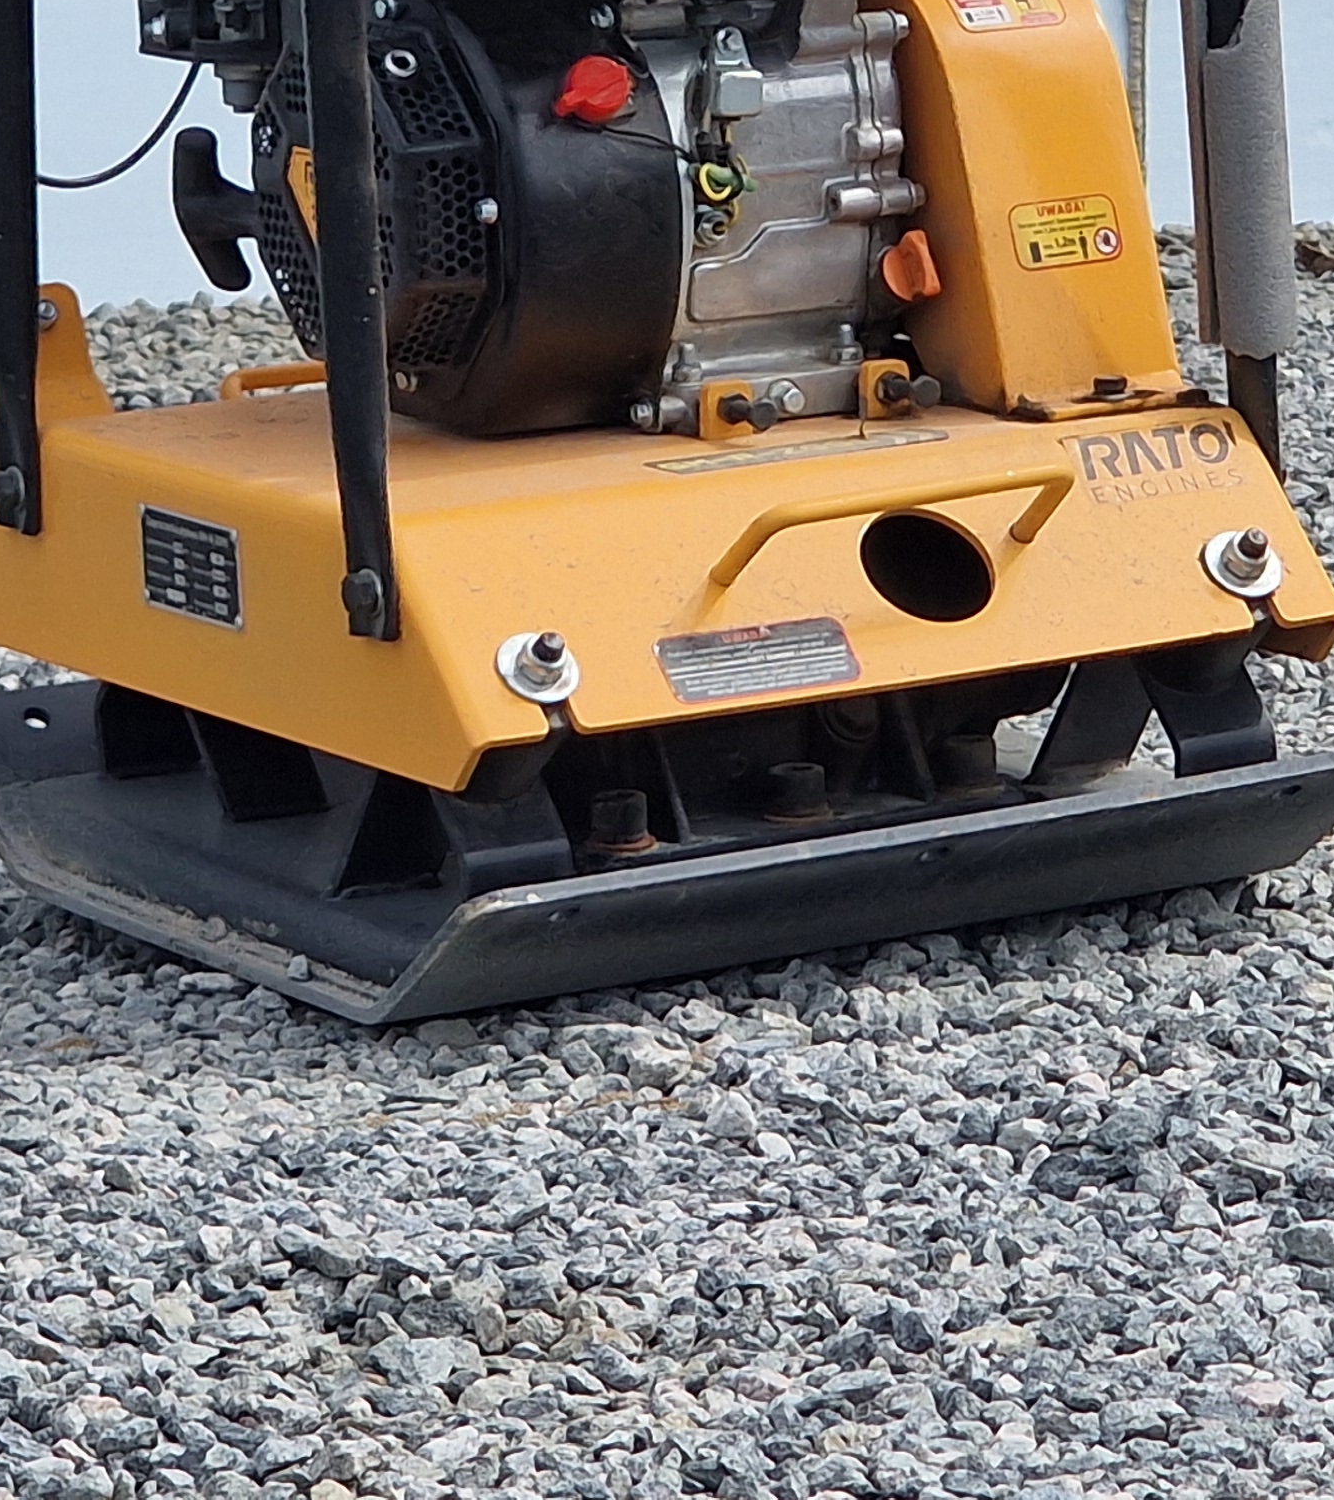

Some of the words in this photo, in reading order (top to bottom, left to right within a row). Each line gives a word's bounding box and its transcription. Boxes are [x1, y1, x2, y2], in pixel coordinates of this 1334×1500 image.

[1036, 200, 1085, 217] UWAGA!
[1078, 423, 1229, 481] RATO
[1091, 468, 1244, 504] ENGINES
